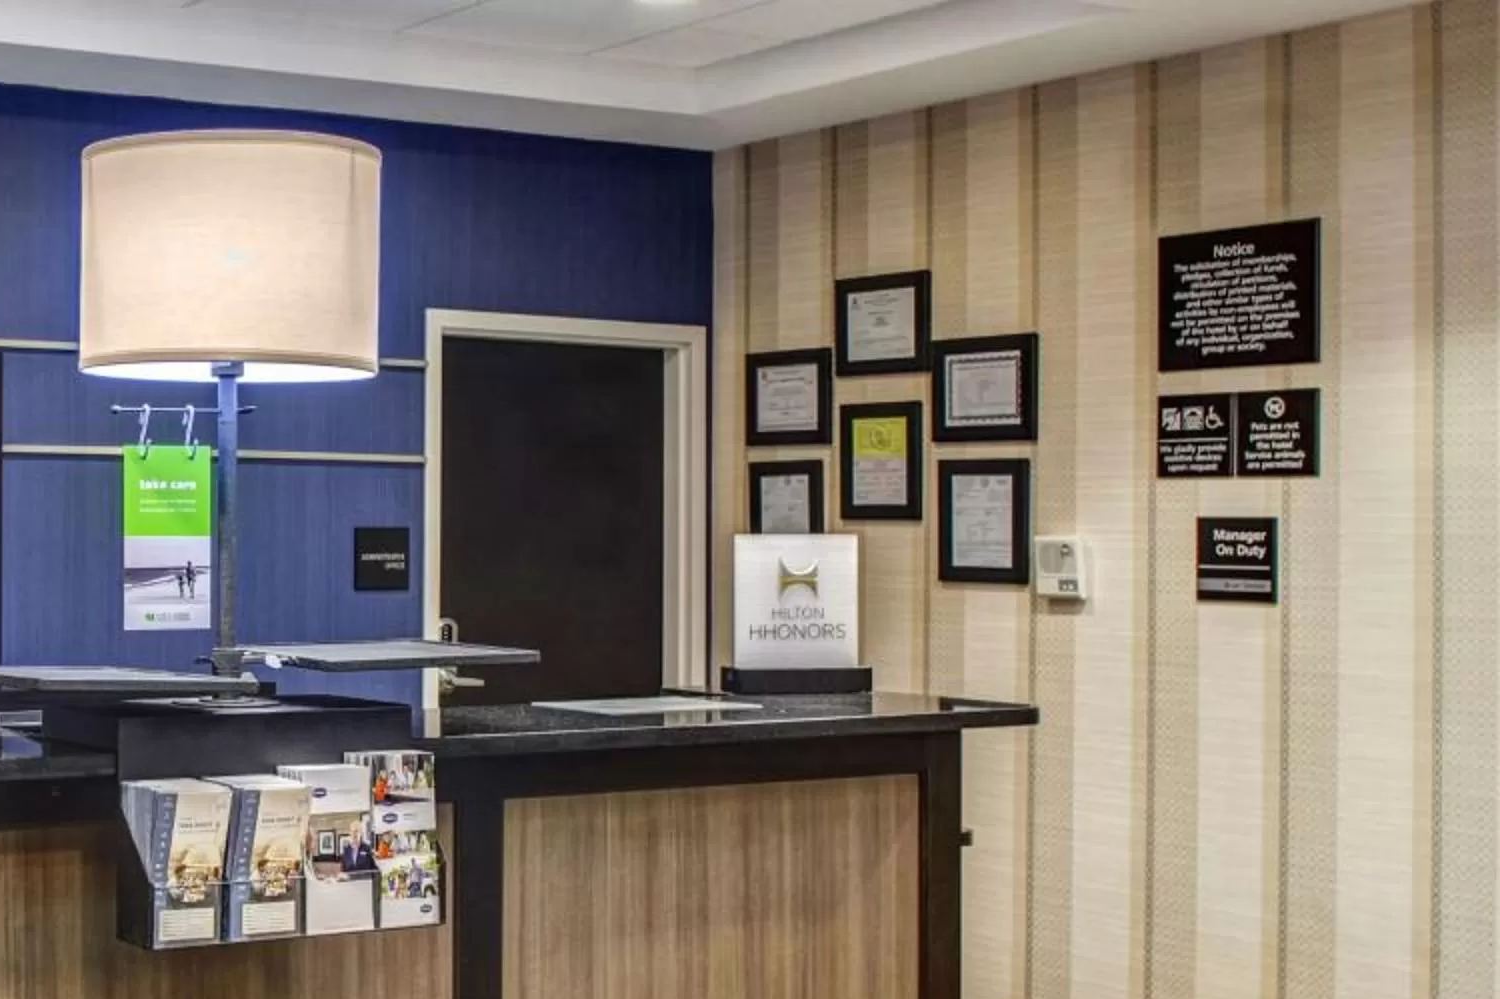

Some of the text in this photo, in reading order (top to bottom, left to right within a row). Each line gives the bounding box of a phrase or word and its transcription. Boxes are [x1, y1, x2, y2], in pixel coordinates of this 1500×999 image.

[1213, 241, 1256, 258] Notice
[1213, 529, 1267, 543] Manager
[1216, 544, 1267, 560] On Duty
[771, 607, 825, 621] HILTON
[749, 623, 846, 641] HHONORS
